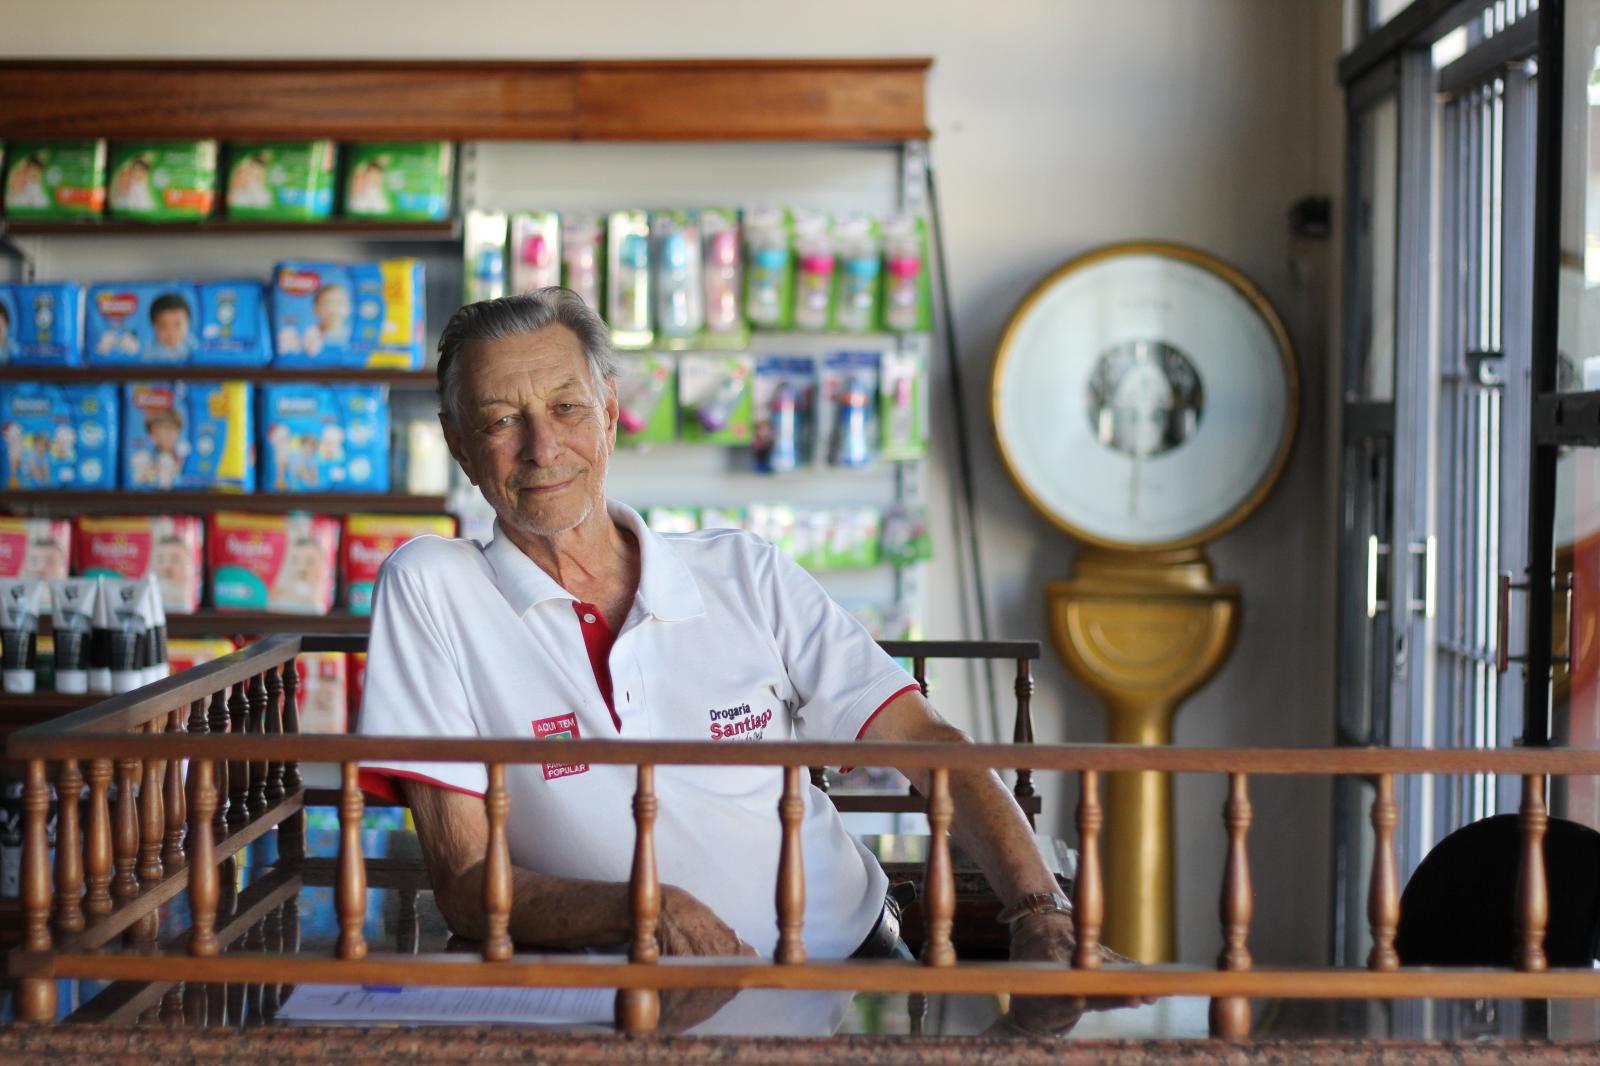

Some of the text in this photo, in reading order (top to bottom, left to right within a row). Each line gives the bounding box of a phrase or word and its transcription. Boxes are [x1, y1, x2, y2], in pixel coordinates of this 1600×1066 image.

[709, 703, 751, 721] Drogaria
[537, 717, 576, 733] AQUI TEM
[710, 708, 772, 741] Santiago
[548, 763, 586, 778] POPULAR
